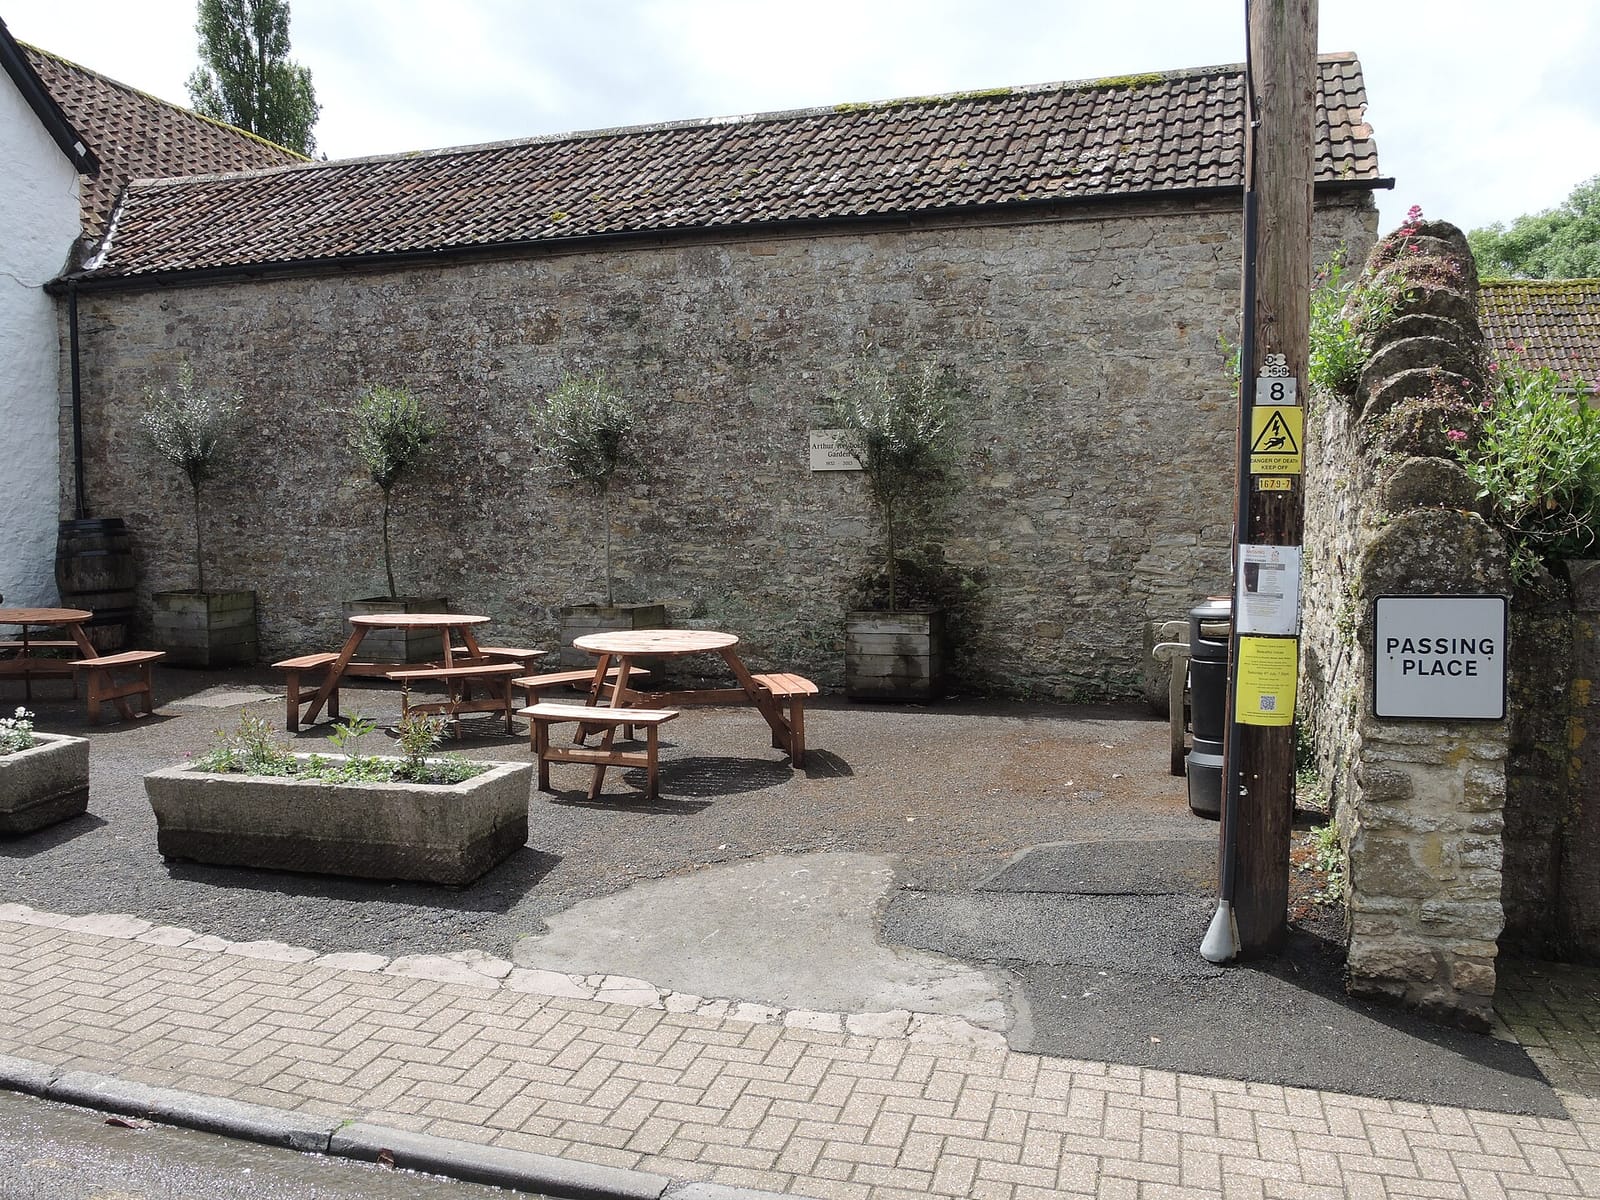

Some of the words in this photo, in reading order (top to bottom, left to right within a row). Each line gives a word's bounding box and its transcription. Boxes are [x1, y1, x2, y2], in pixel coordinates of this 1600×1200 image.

[1270, 382, 1285, 401] 8
[1386, 638, 1494, 655] PASSING
[1402, 660, 1478, 676] PLACE
